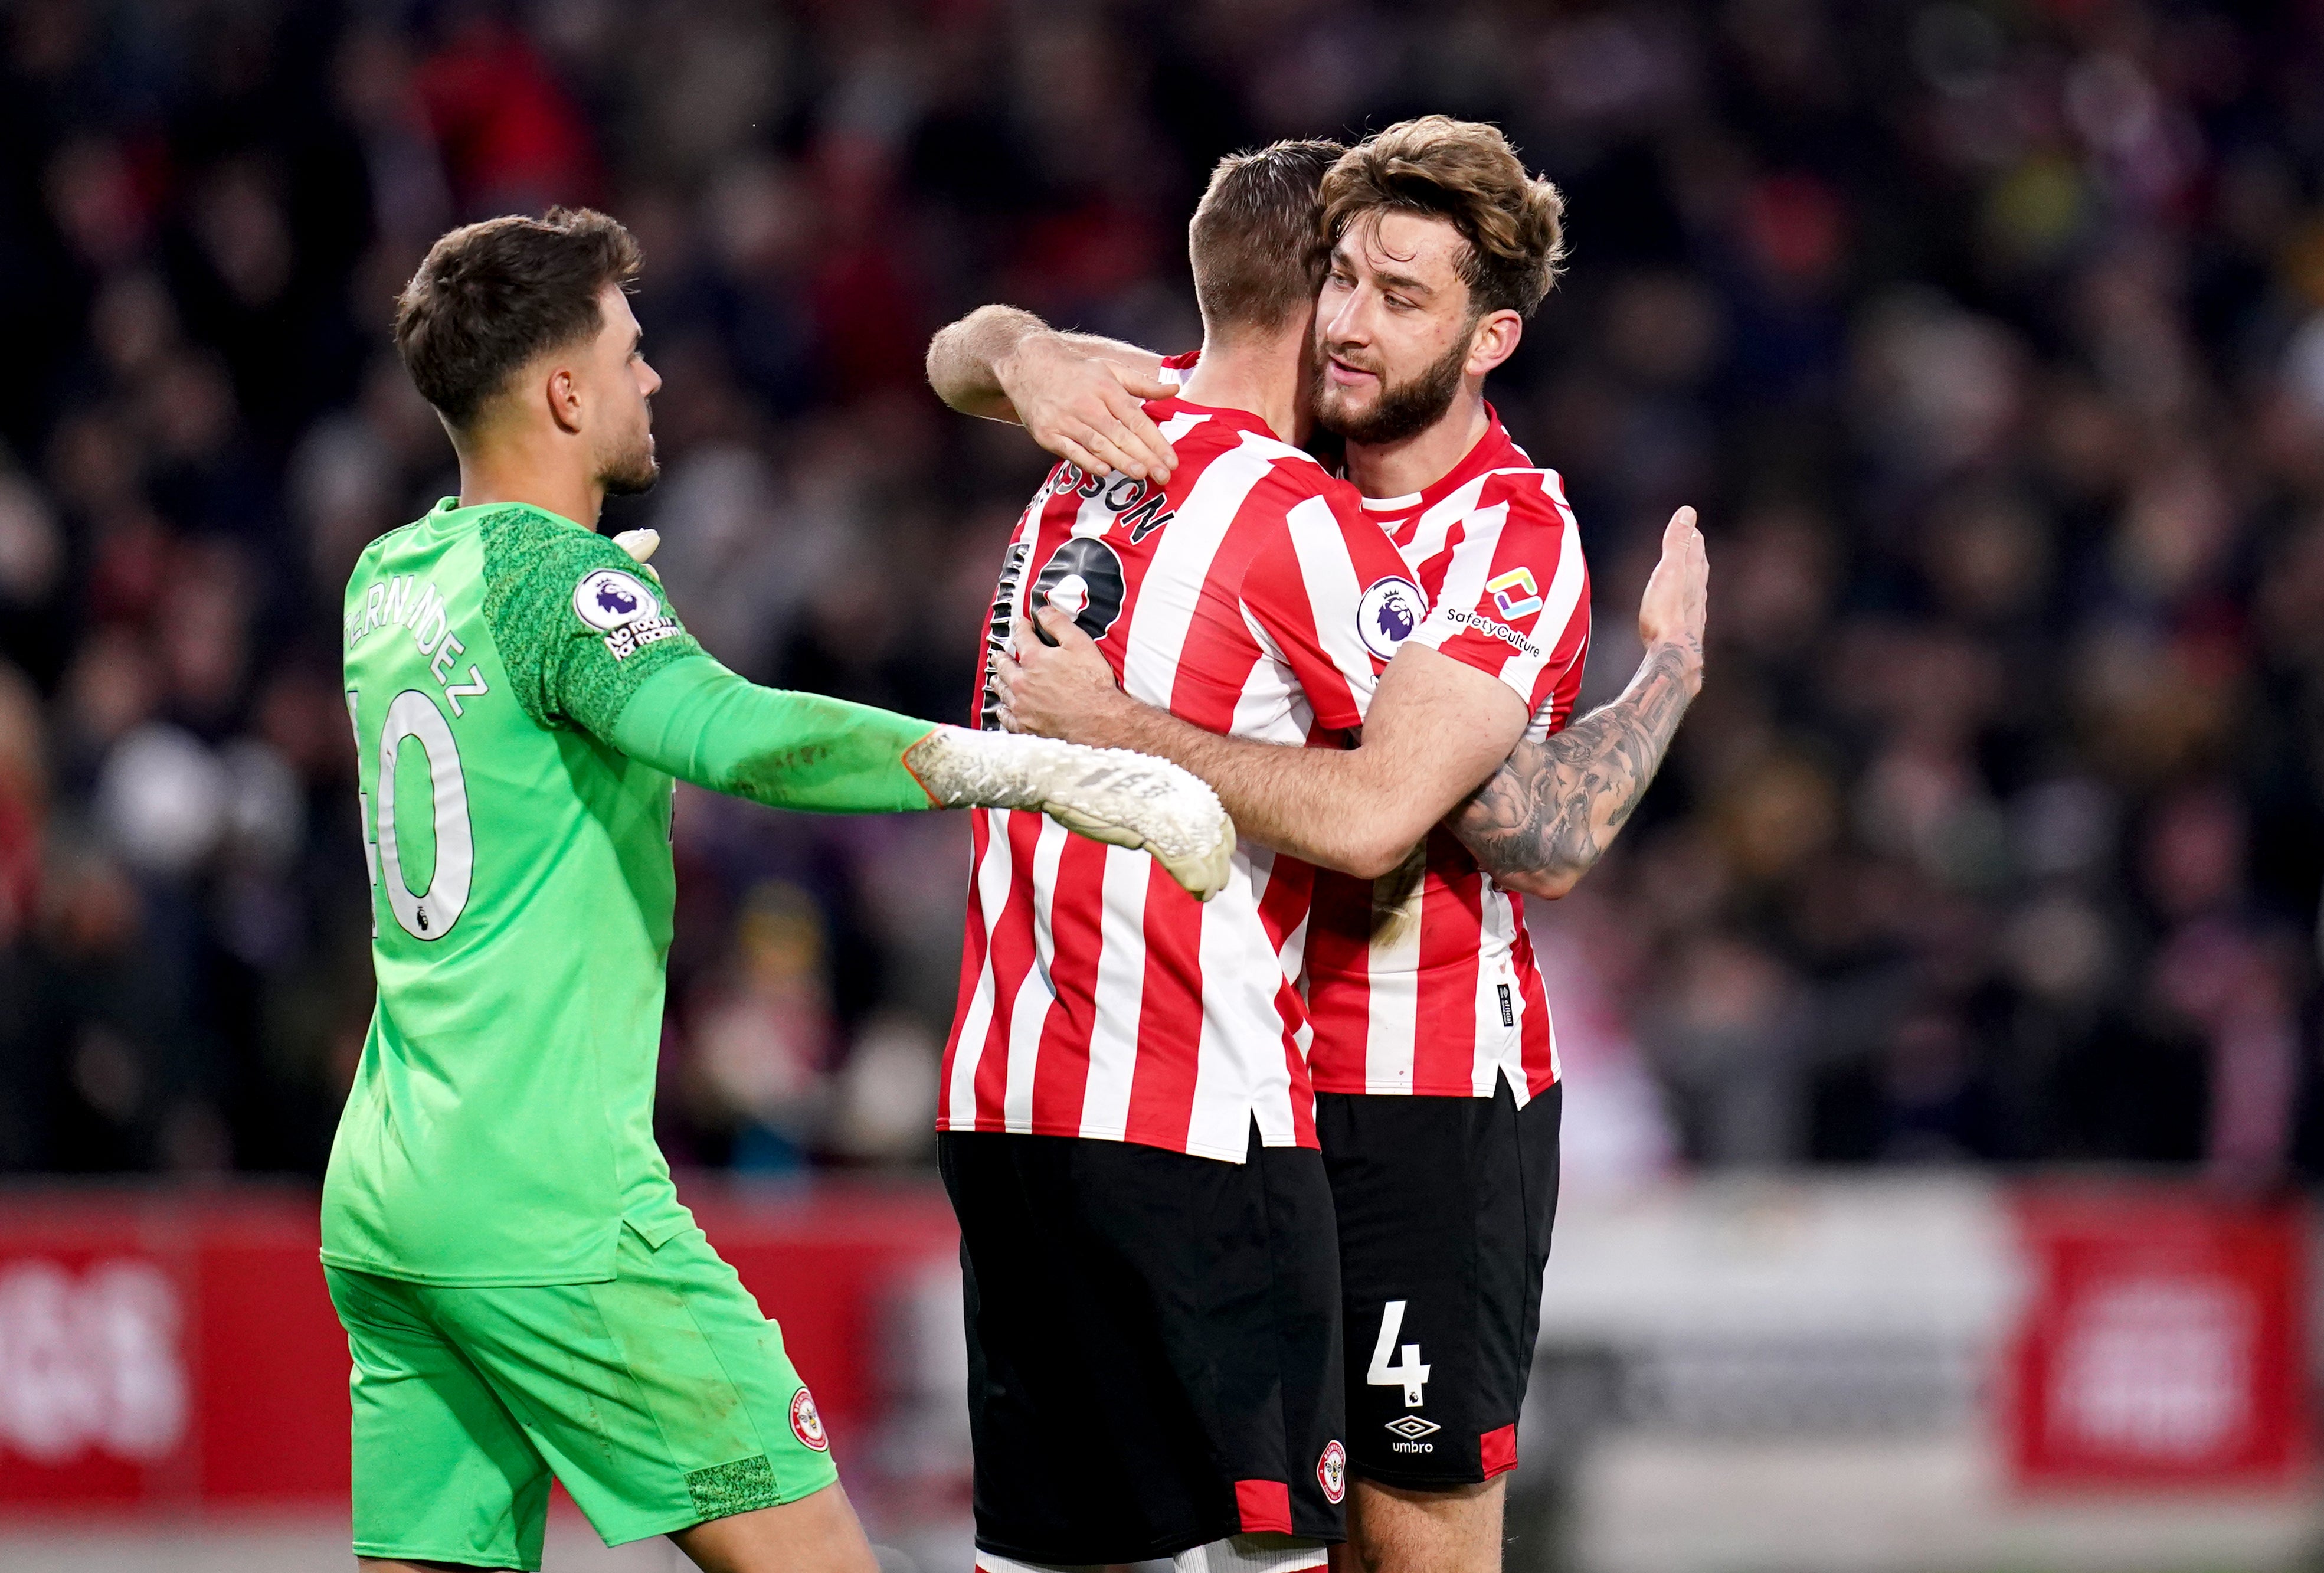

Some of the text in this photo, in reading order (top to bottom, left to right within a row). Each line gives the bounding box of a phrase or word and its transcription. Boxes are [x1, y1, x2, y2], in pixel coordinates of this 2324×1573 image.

[343, 574, 489, 719] FERNNDEZ
[604, 617, 674, 648] No room
[611, 626, 681, 662] for racism
[1447, 608, 1540, 658] SafetyCulture
[346, 689, 474, 941] 0
[1367, 1301, 1431, 1407] 4
[1392, 1441, 1433, 1453] umbro
